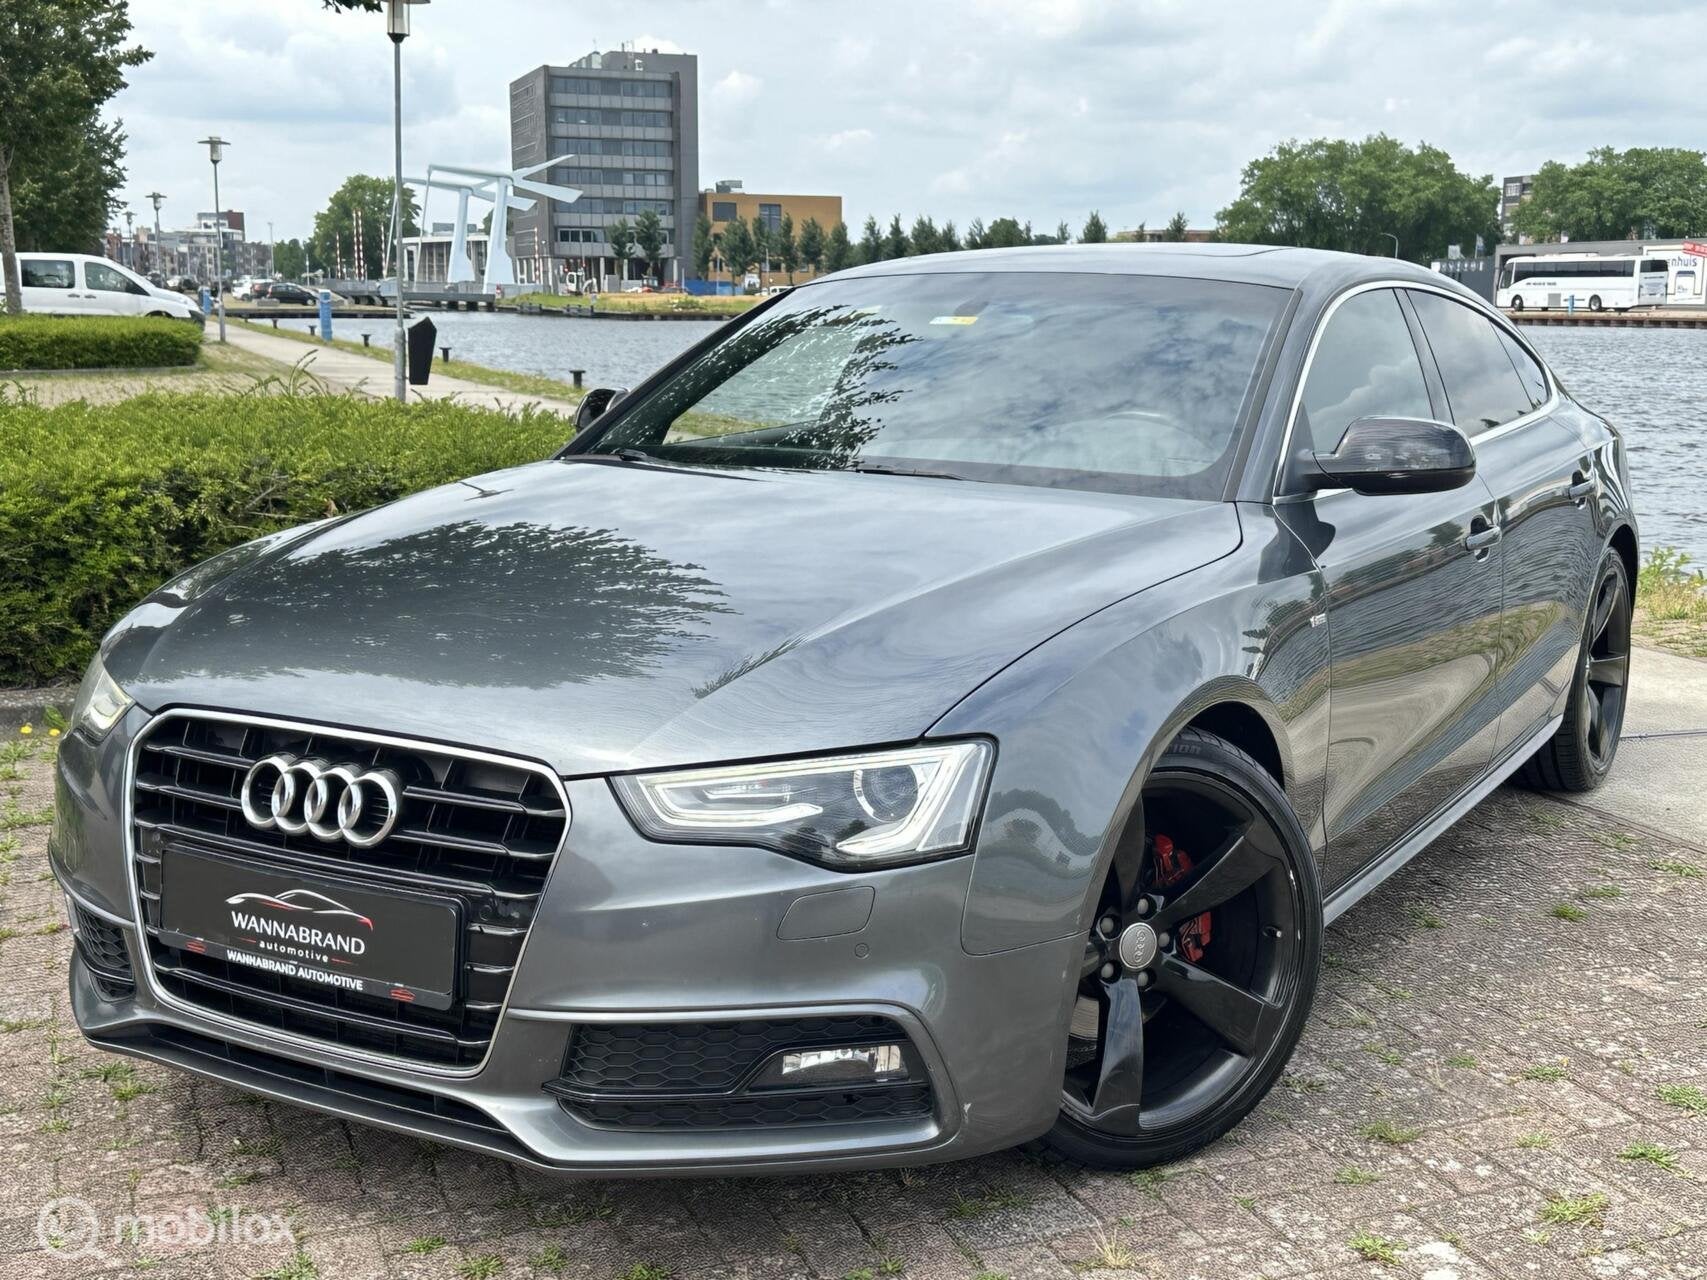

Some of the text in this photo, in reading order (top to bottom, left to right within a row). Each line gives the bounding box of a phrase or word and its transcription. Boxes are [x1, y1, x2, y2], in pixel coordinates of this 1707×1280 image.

[231, 911, 365, 955] WANNABRAND
[259, 940, 329, 963] automotive
[226, 949, 364, 991] WANNABRAND AUTOMOTIVE
